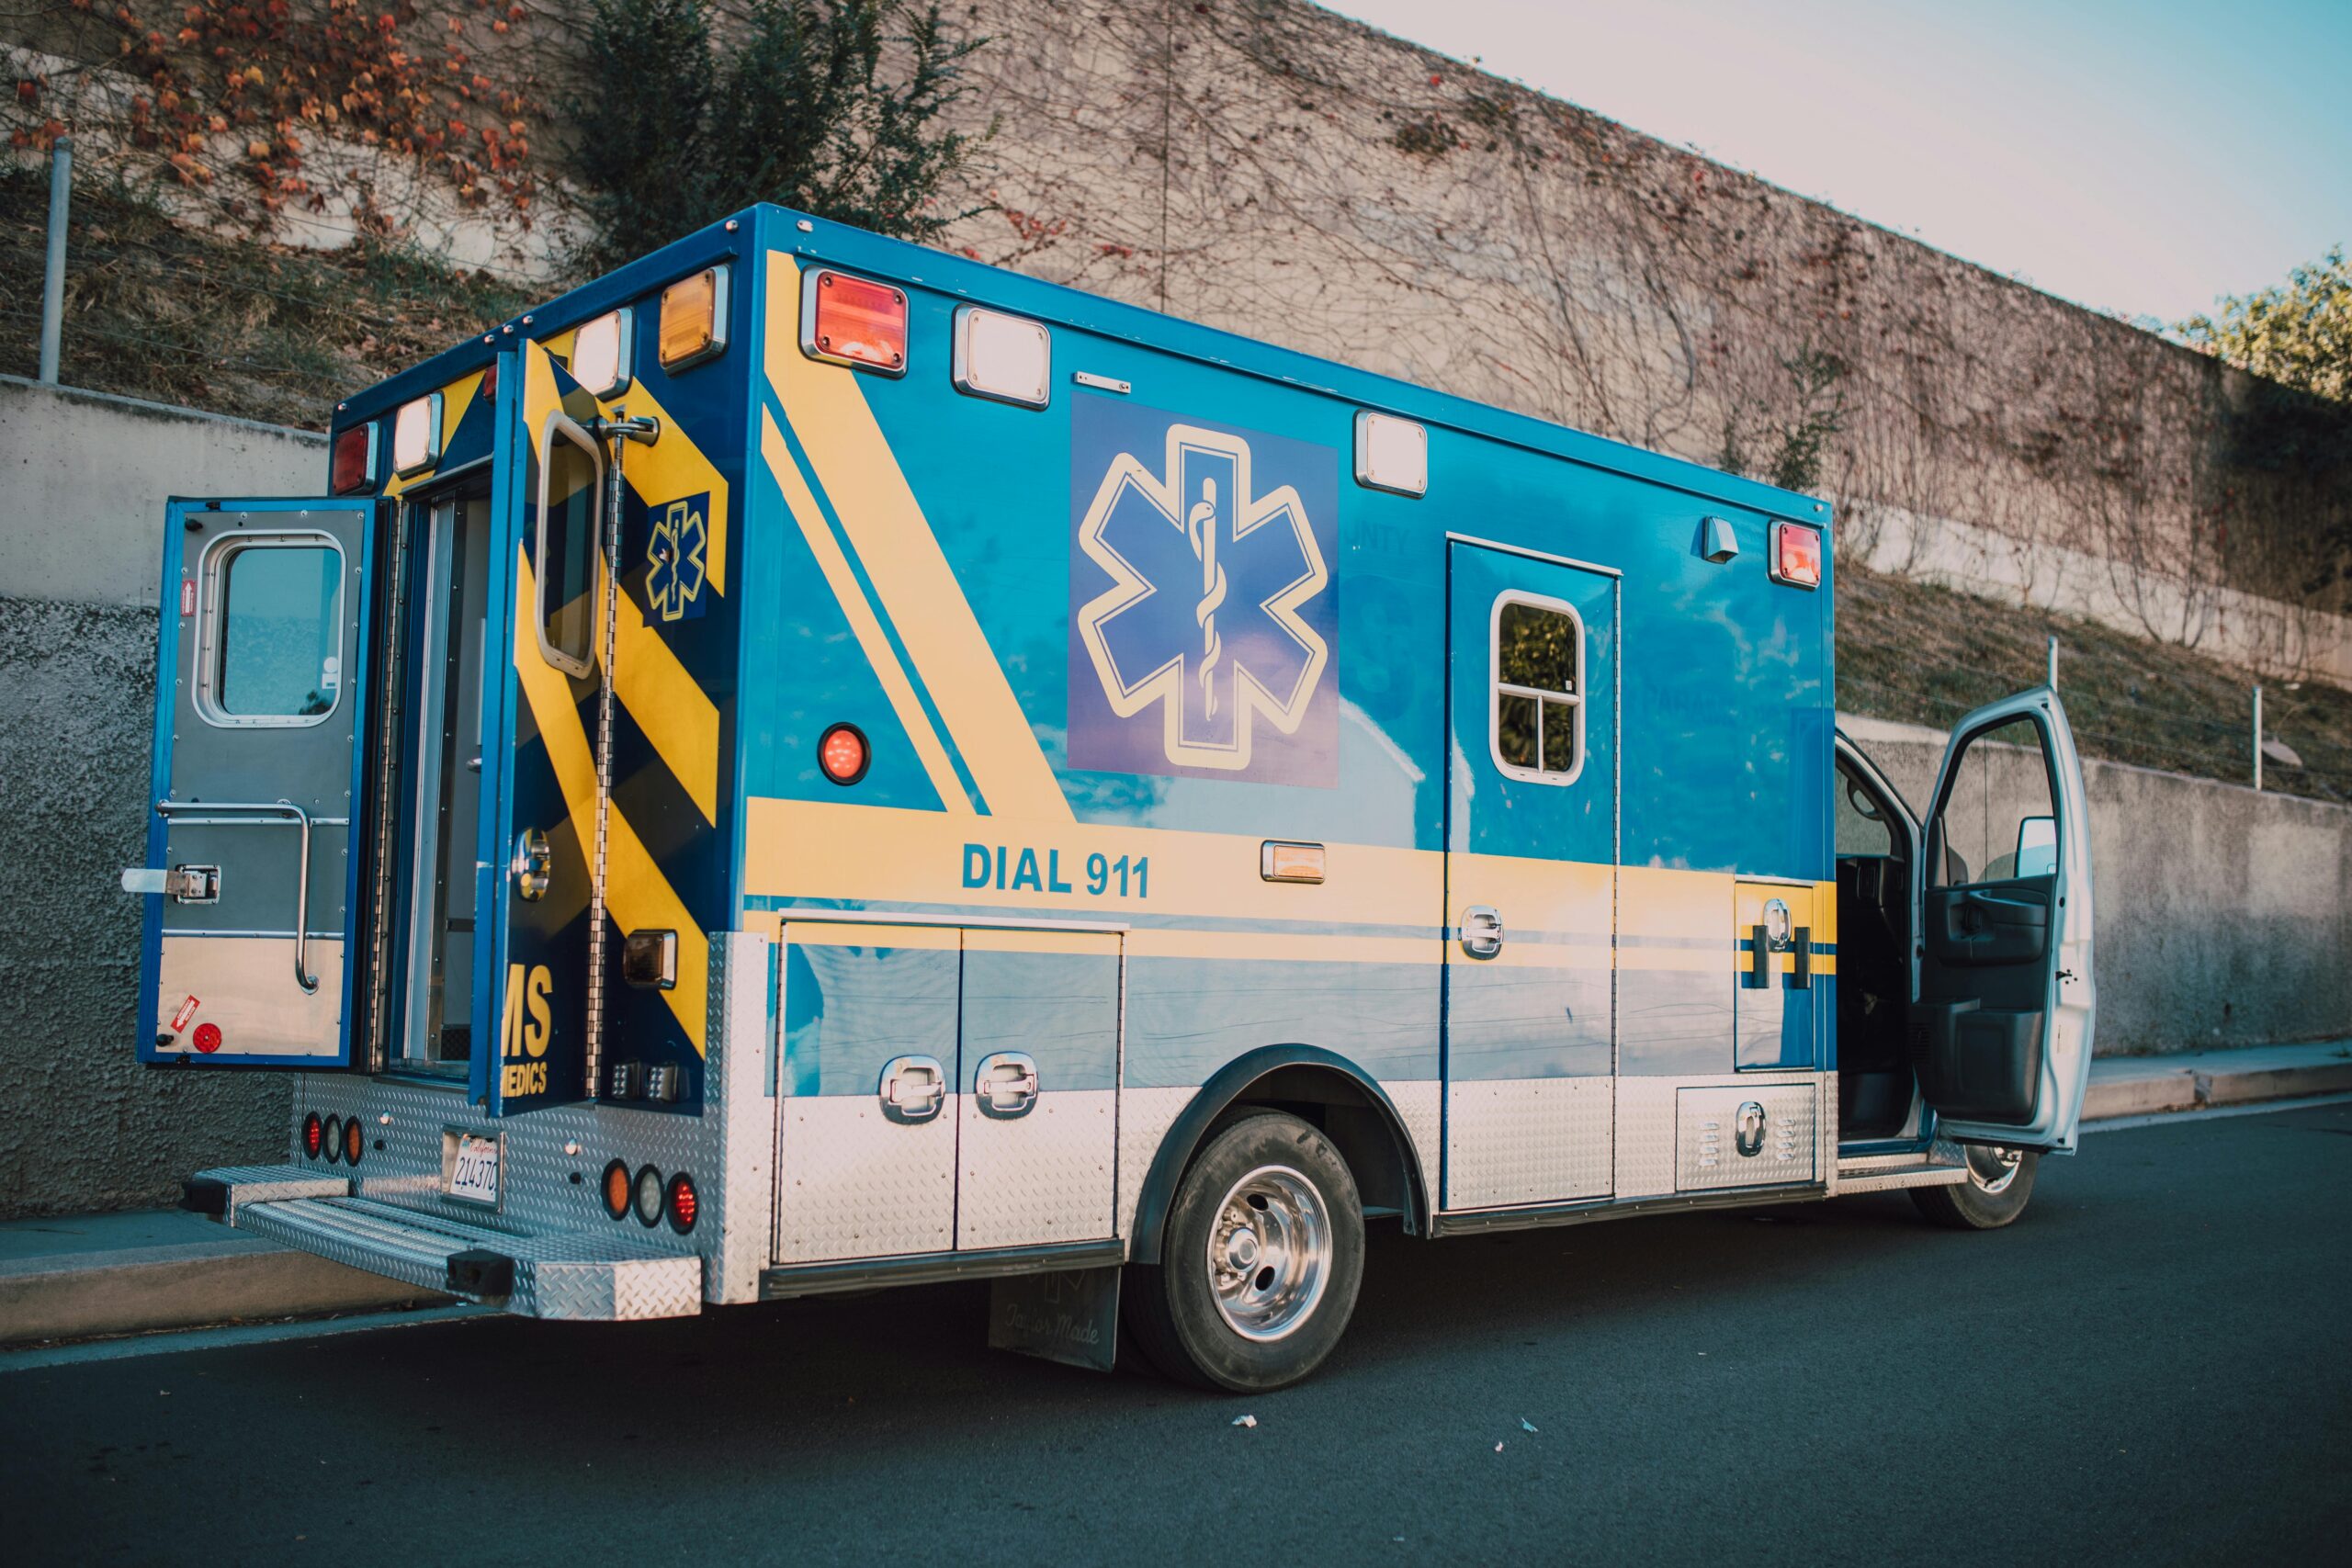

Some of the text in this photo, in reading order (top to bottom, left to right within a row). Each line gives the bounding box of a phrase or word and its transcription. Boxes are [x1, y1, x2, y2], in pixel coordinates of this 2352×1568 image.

[962, 843, 1148, 898] DIAL 911
[1005, 1303, 1101, 1346] Taylor Made
